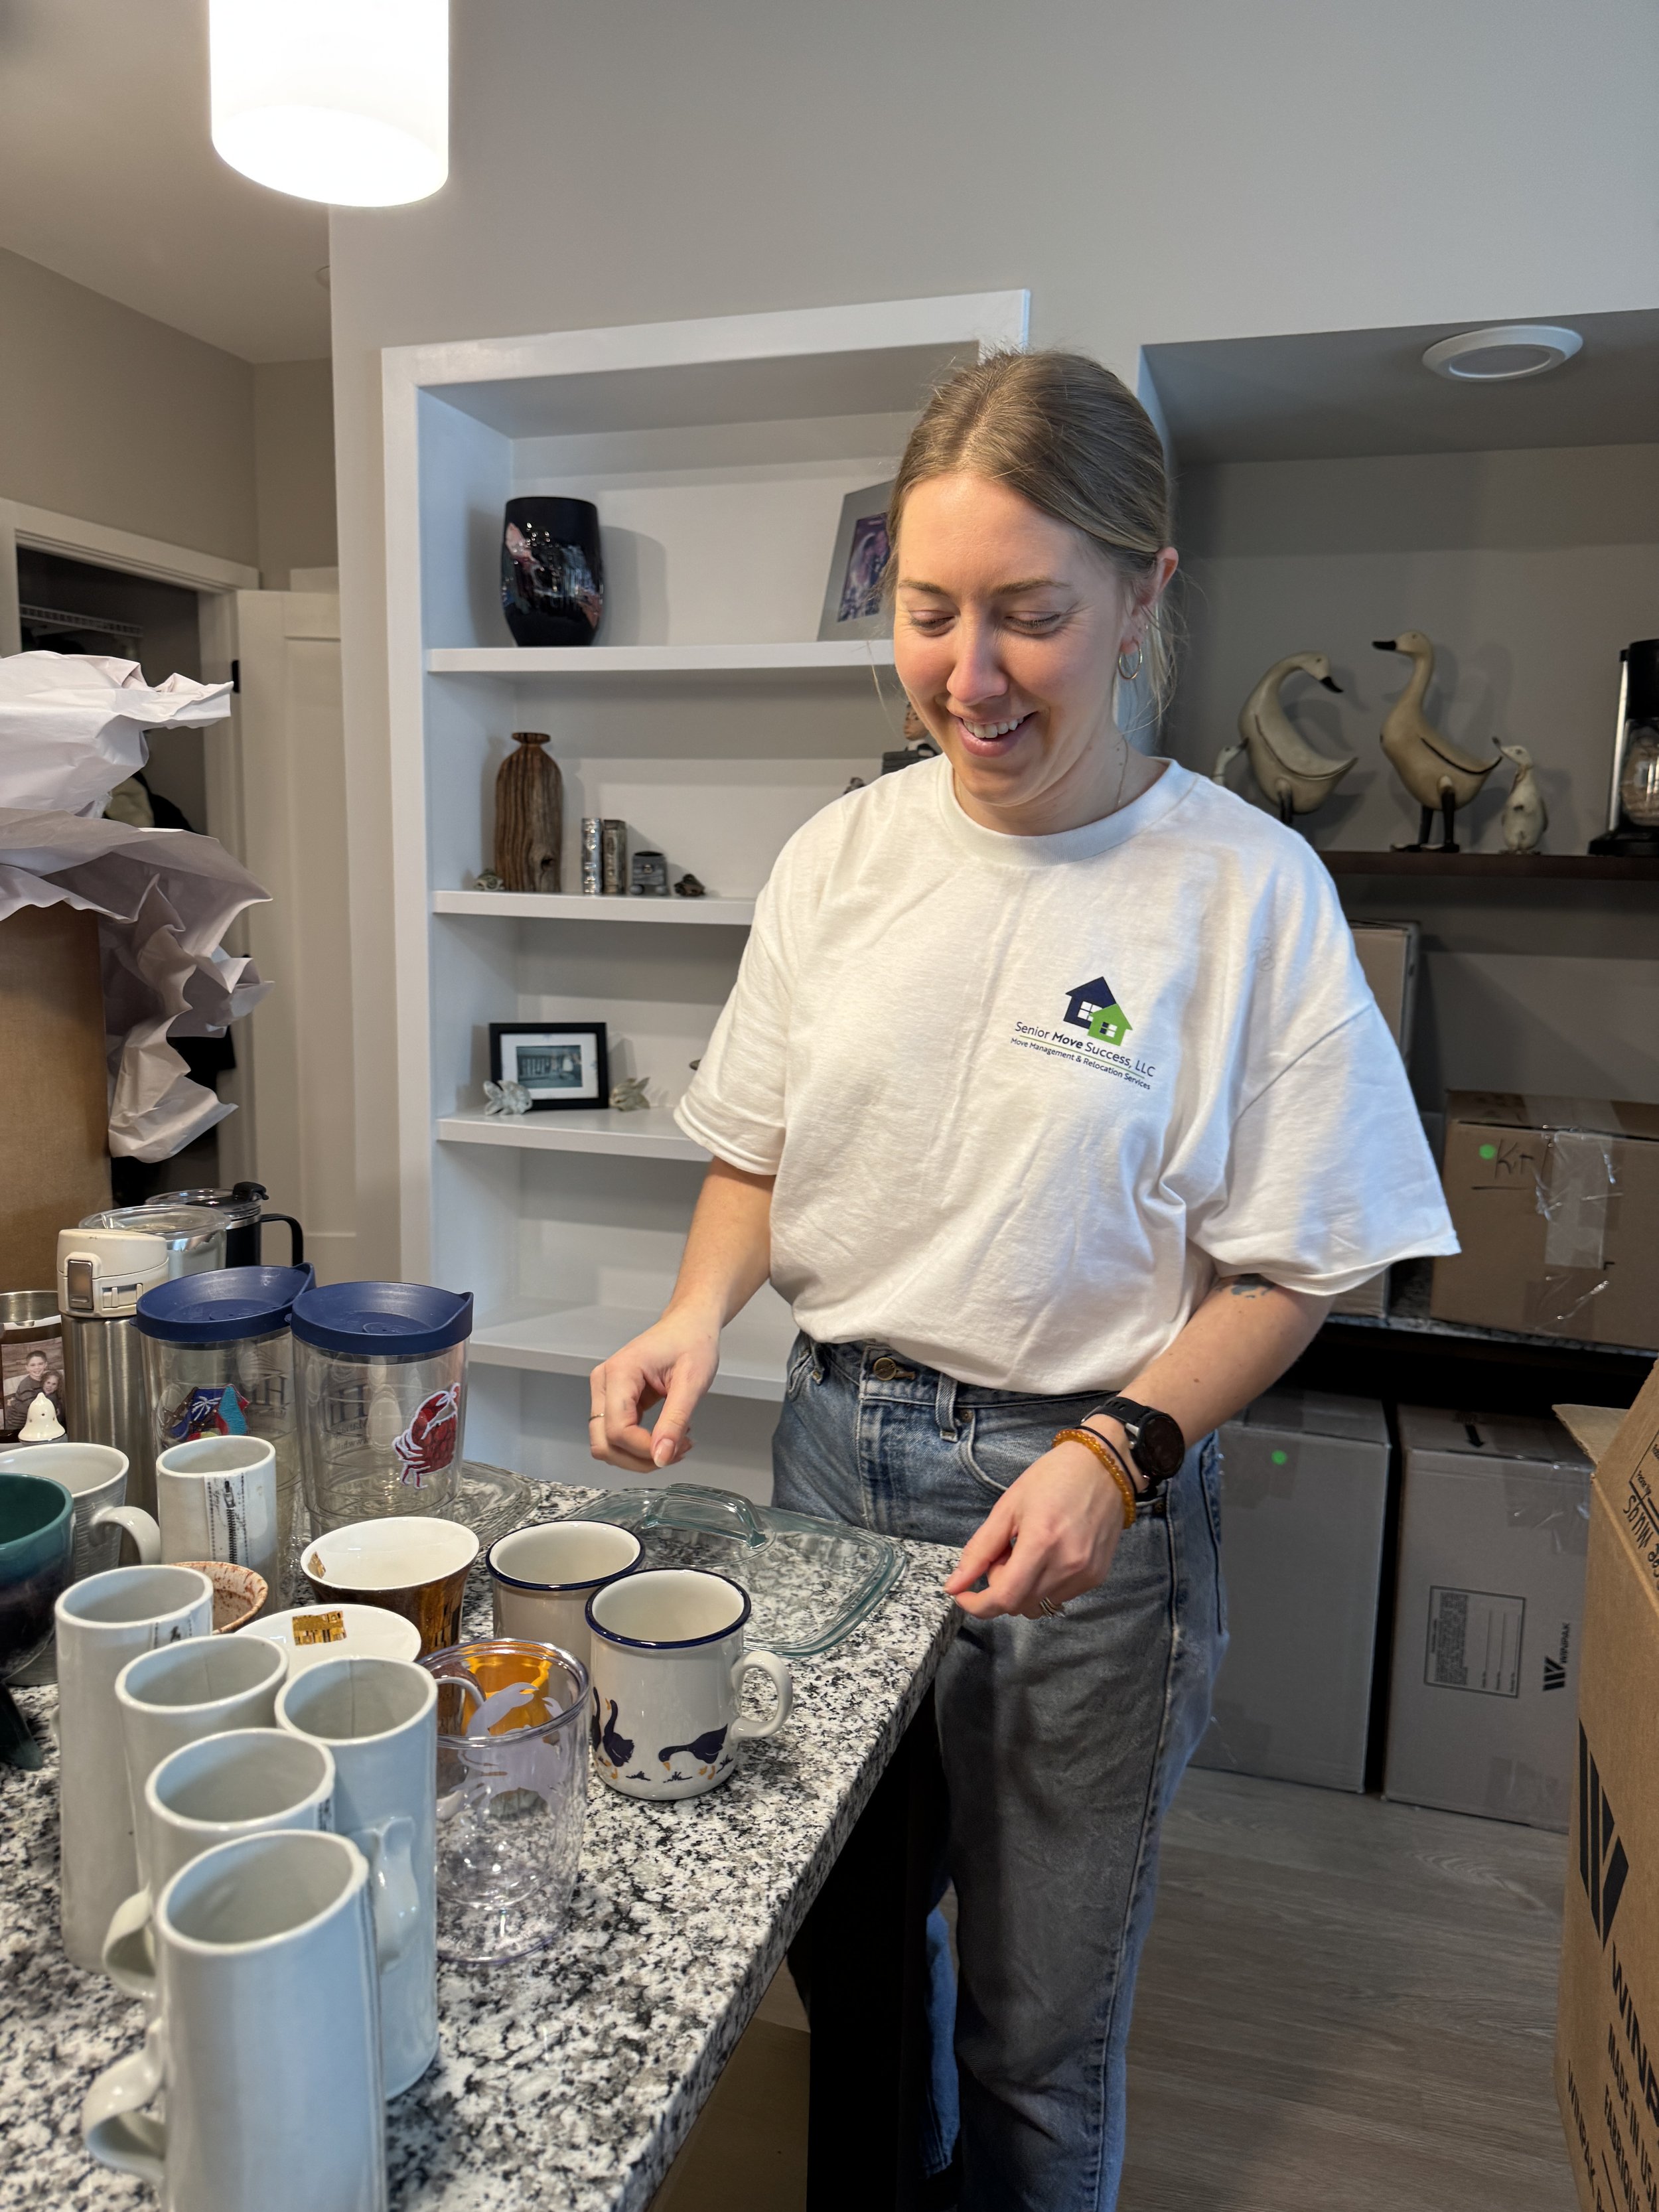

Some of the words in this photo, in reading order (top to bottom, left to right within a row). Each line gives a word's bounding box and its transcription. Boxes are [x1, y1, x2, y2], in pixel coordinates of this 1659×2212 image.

[1010, 1037, 1029, 1048] Move
[1029, 1042, 1074, 1061] Management
[1083, 1058, 1123, 1078] Relocation
[1124, 1072, 1151, 1090] Services
[1015, 1021, 1050, 1039] Senior
[1052, 1031, 1083, 1049] Move
[1084, 1041, 1132, 1069] Success,
[1135, 1060, 1156, 1077] LLC
[1608, 2023, 1629, 2119] MADE
[1613, 1941, 1659, 2141] WINP
